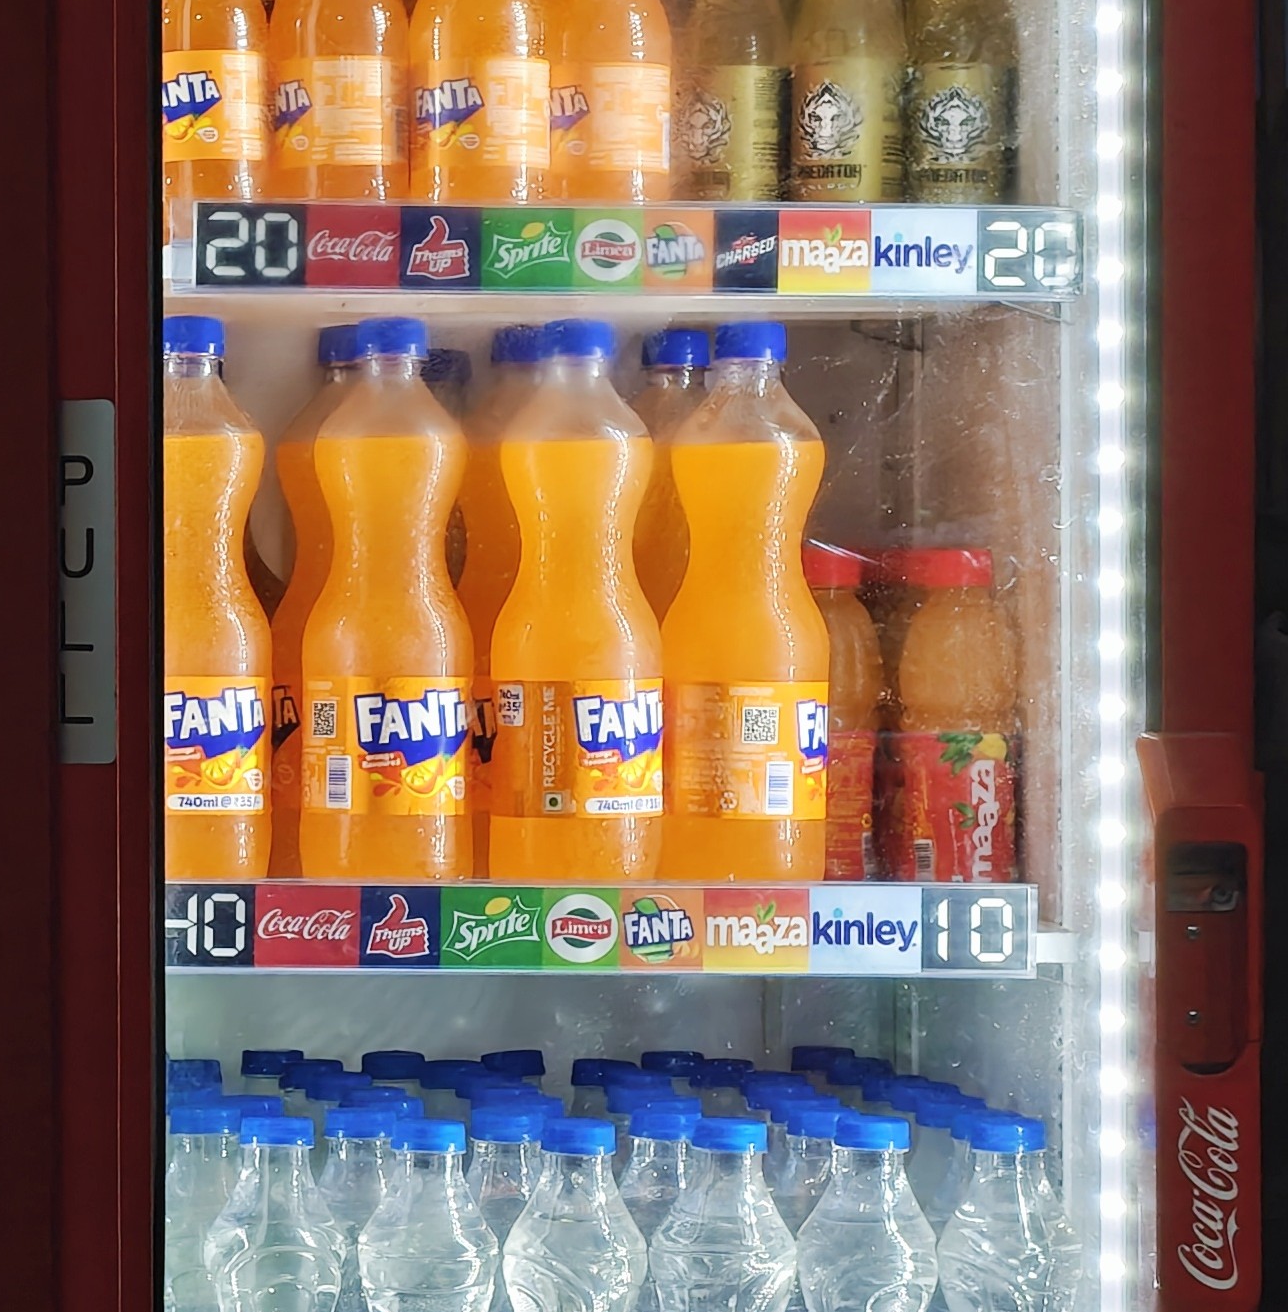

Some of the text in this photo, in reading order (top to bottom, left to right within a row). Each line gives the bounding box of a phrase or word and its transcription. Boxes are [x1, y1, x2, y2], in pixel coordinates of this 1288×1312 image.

[206, 211, 299, 277] 20
[307, 229, 397, 263] Coca-Cola
[499, 232, 561, 273] Sprite
[581, 241, 638, 258] Limca
[646, 236, 705, 266] FANTA
[716, 237, 775, 270] CHARGED
[782, 238, 869, 273] maaza
[874, 233, 973, 273] kinley
[985, 221, 1076, 287] 20
[59, 455, 94, 724] PULL
[164, 688, 265, 740] FANTA
[356, 691, 468, 744] FANTA
[543, 686, 556, 787] RECYCLE ME
[177, 796, 218, 808] 740ml
[257, 908, 352, 941] Coca-Cola
[455, 908, 531, 949] Sprite
[553, 920, 609, 935] Limca
[625, 914, 693, 943] FANTA
[706, 915, 808, 953] maaza
[813, 911, 918, 950] kinley
[937, 897, 1012, 962] 10
[1178, 1095, 1239, 1290] Coca-Cola
